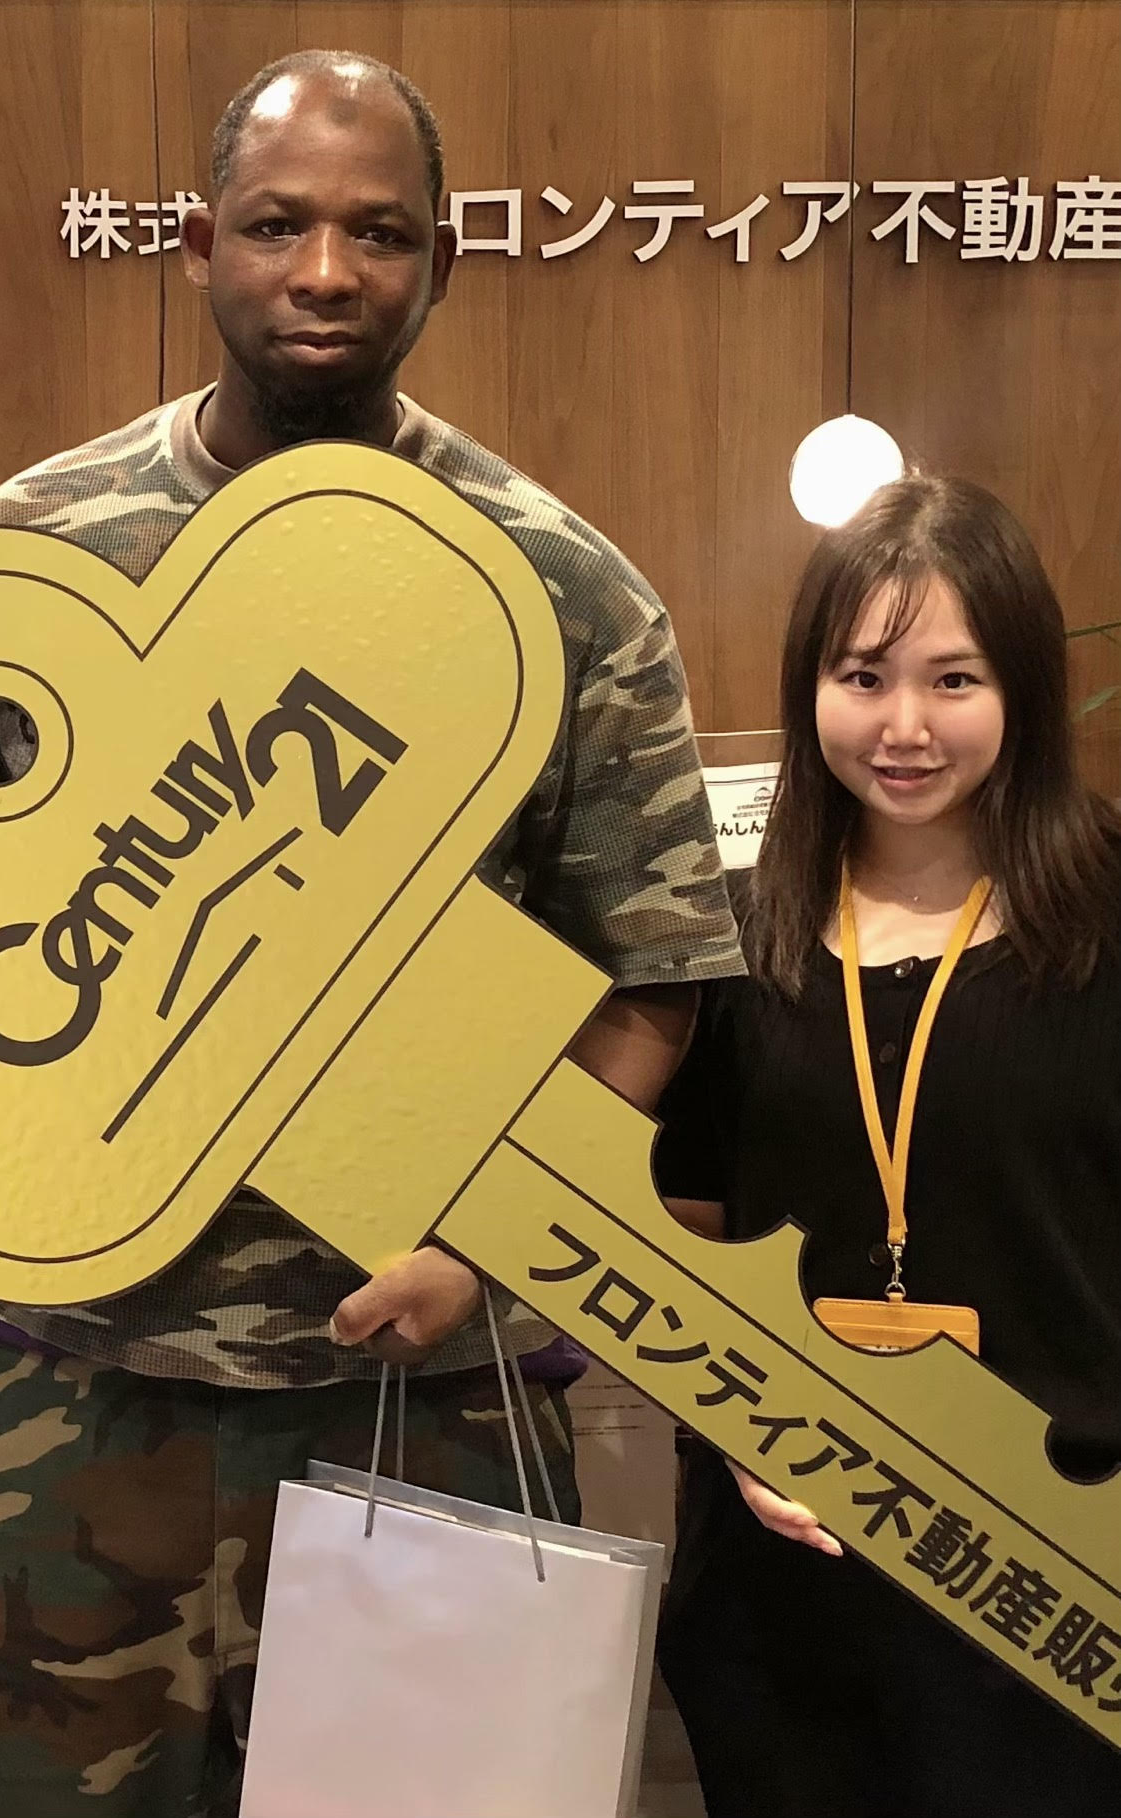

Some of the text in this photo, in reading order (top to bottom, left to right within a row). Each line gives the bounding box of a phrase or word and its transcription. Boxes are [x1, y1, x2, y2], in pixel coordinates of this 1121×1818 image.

[713, 820, 768, 836] んしん
[528, 1222, 1121, 1712] フロンティア不動産販
